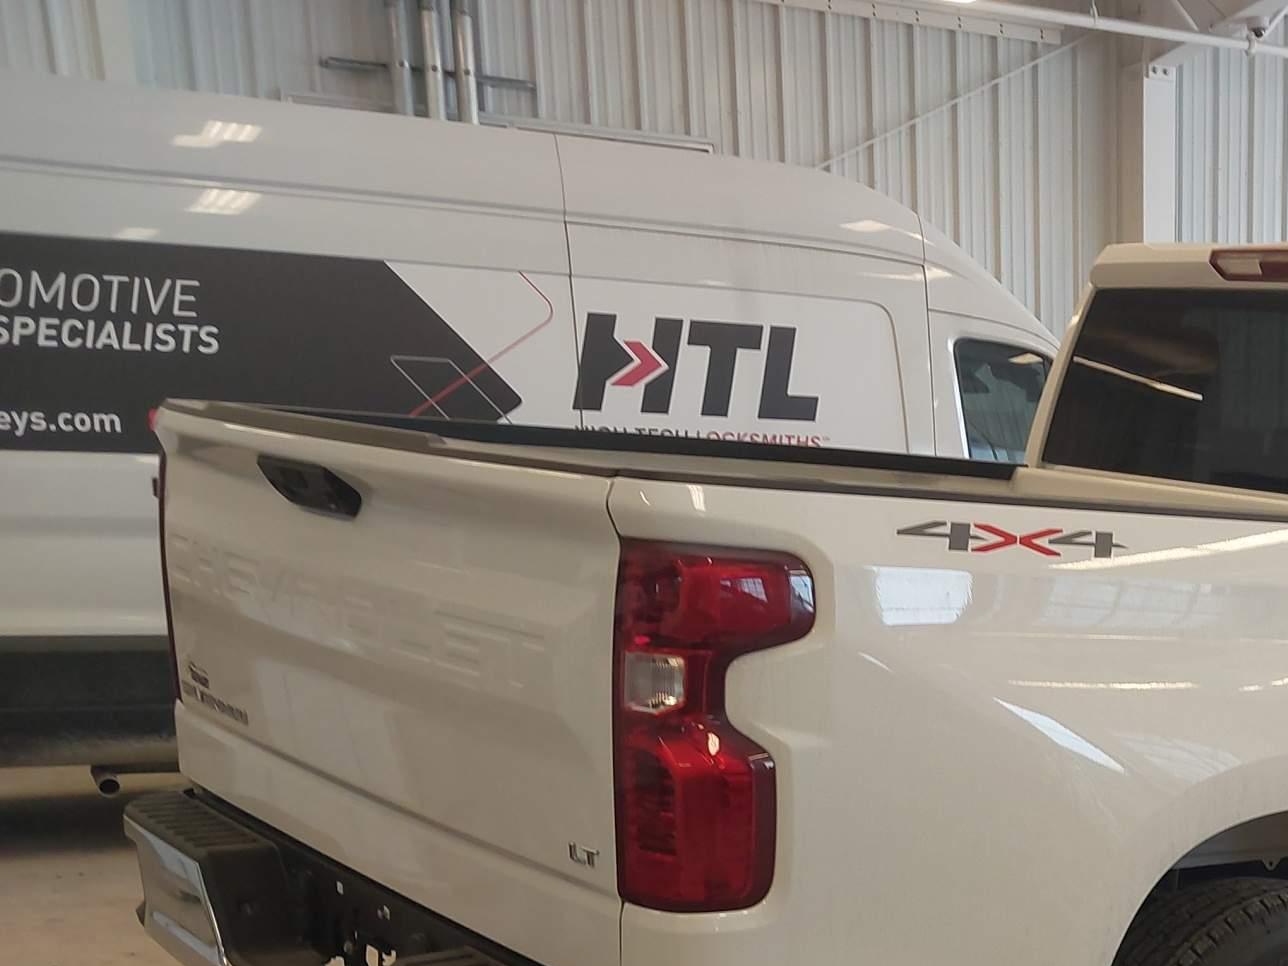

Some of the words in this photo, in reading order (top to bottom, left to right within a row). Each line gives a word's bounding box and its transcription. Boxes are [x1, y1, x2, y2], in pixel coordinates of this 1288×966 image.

[0, 268, 201, 318] OMOTIVE
[572, 312, 819, 422] HTL
[0, 409, 122, 437] eys.com
[568, 841, 600, 868] LT
